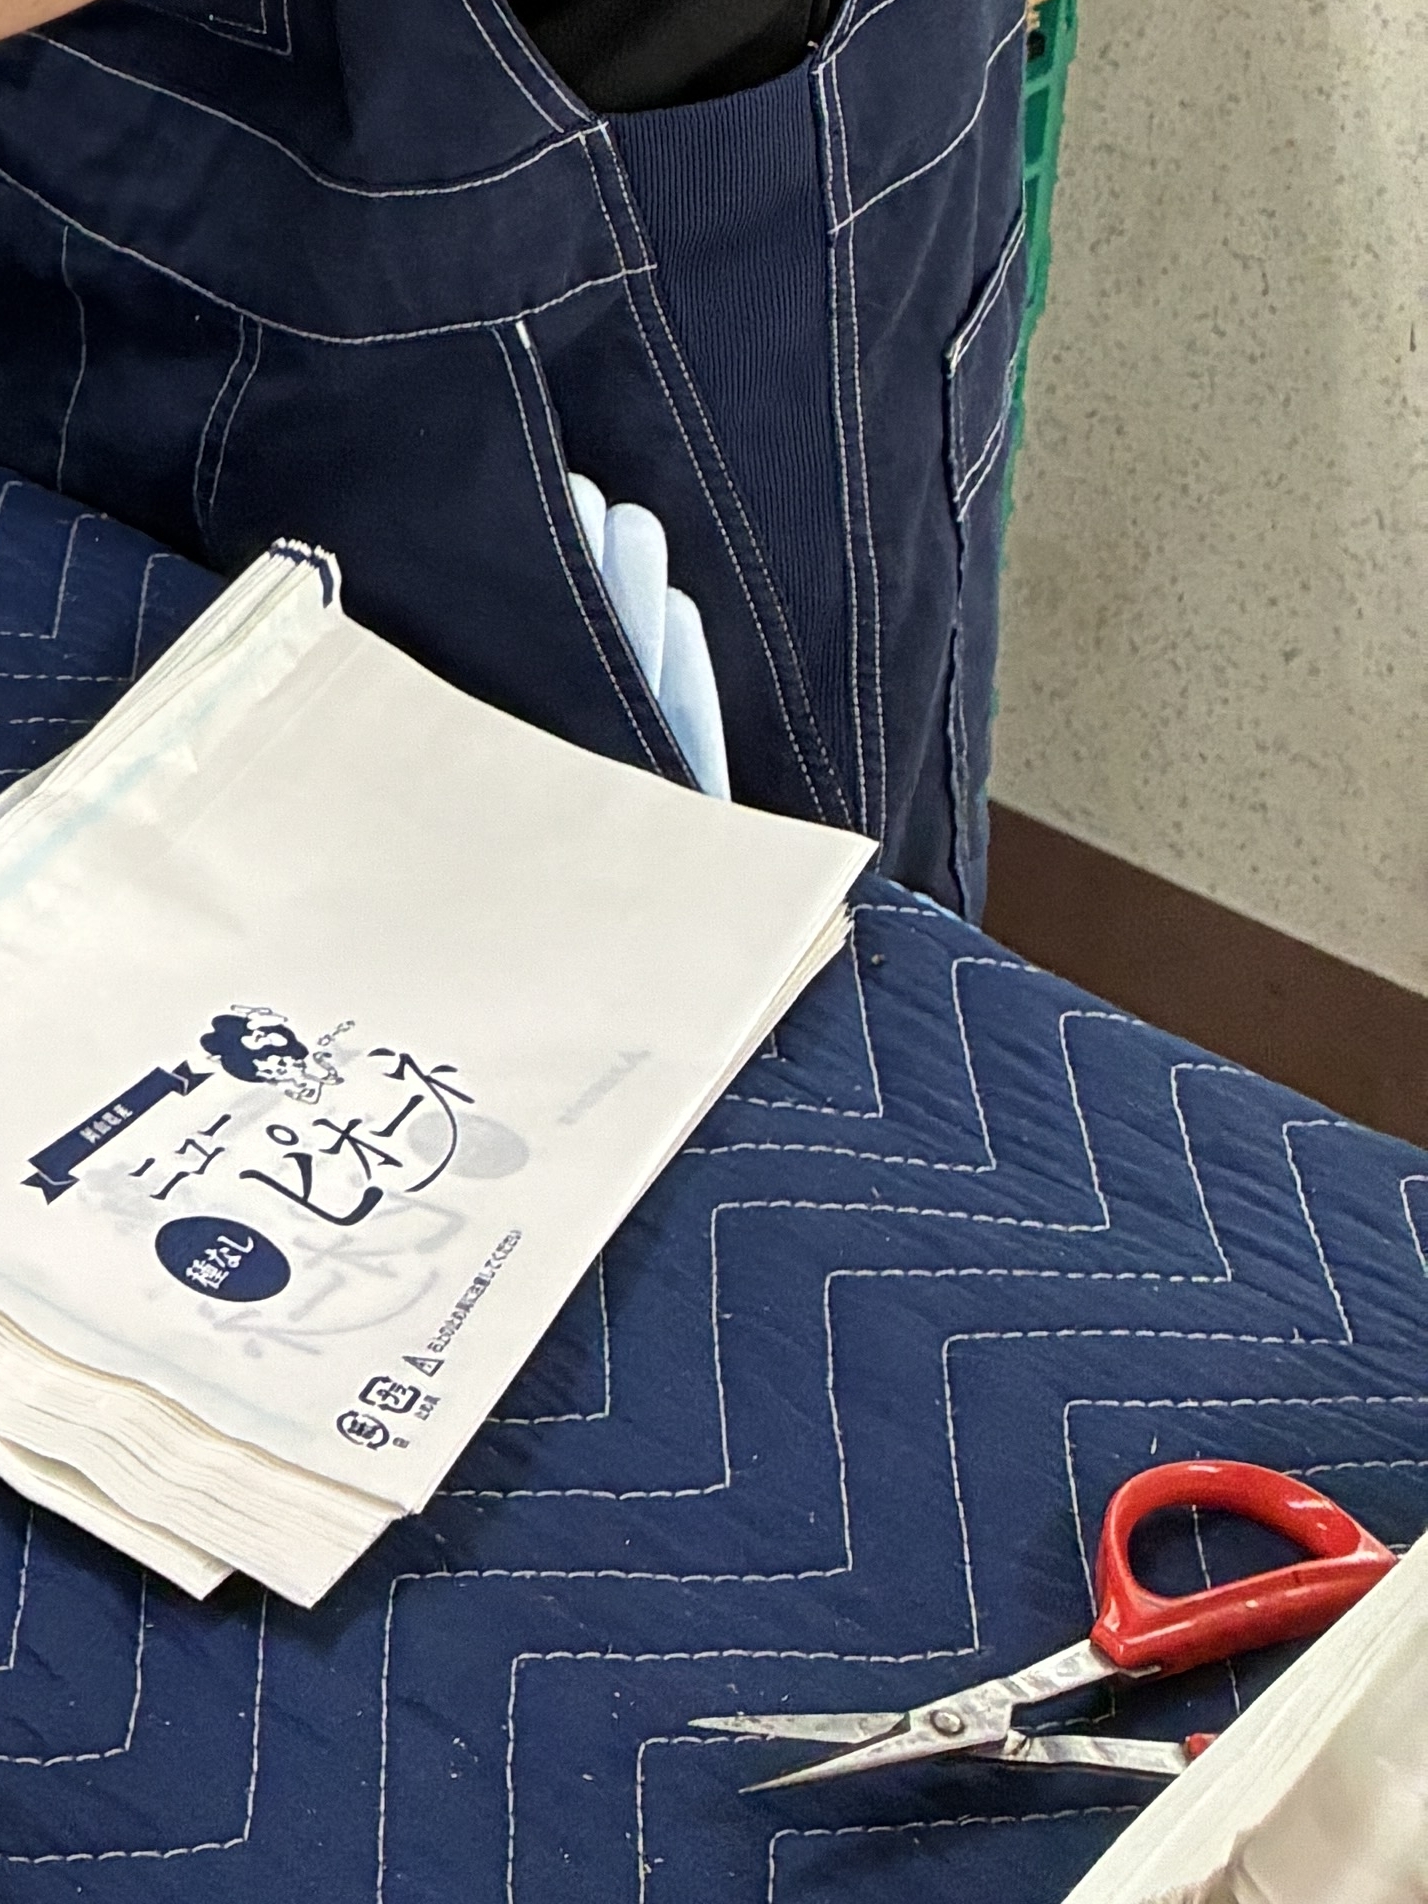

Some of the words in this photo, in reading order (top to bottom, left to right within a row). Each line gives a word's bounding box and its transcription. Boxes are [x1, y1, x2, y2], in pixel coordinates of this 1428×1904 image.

[128, 1113, 232, 1201] ニュー
[239, 1046, 477, 1228] ピオーネ
[184, 1231, 256, 1291] 種なし
